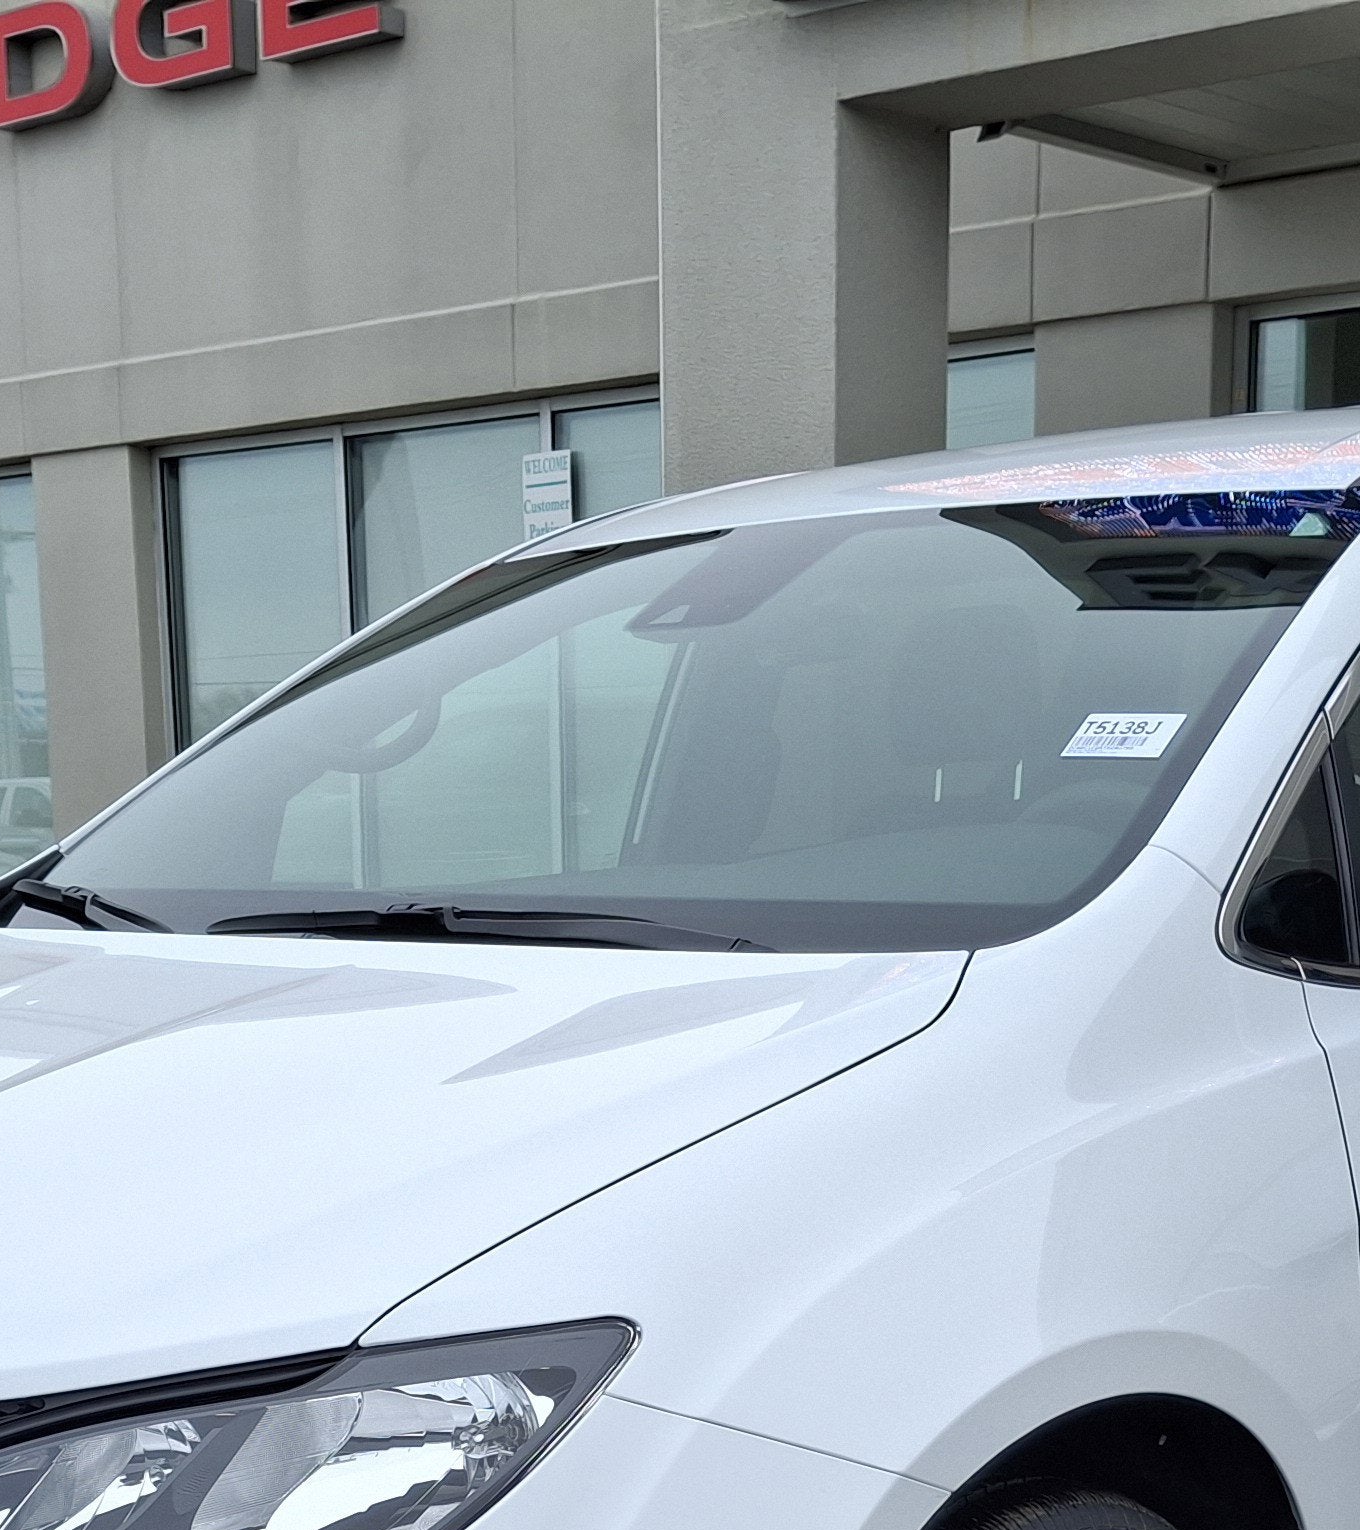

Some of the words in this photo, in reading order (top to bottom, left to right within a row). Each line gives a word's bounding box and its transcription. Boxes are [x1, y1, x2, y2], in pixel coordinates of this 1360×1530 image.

[524, 456, 568, 475] WELCOME
[524, 499, 570, 514] Customer
[530, 521, 565, 540] Parki
[1083, 721, 1164, 735] T5138J
